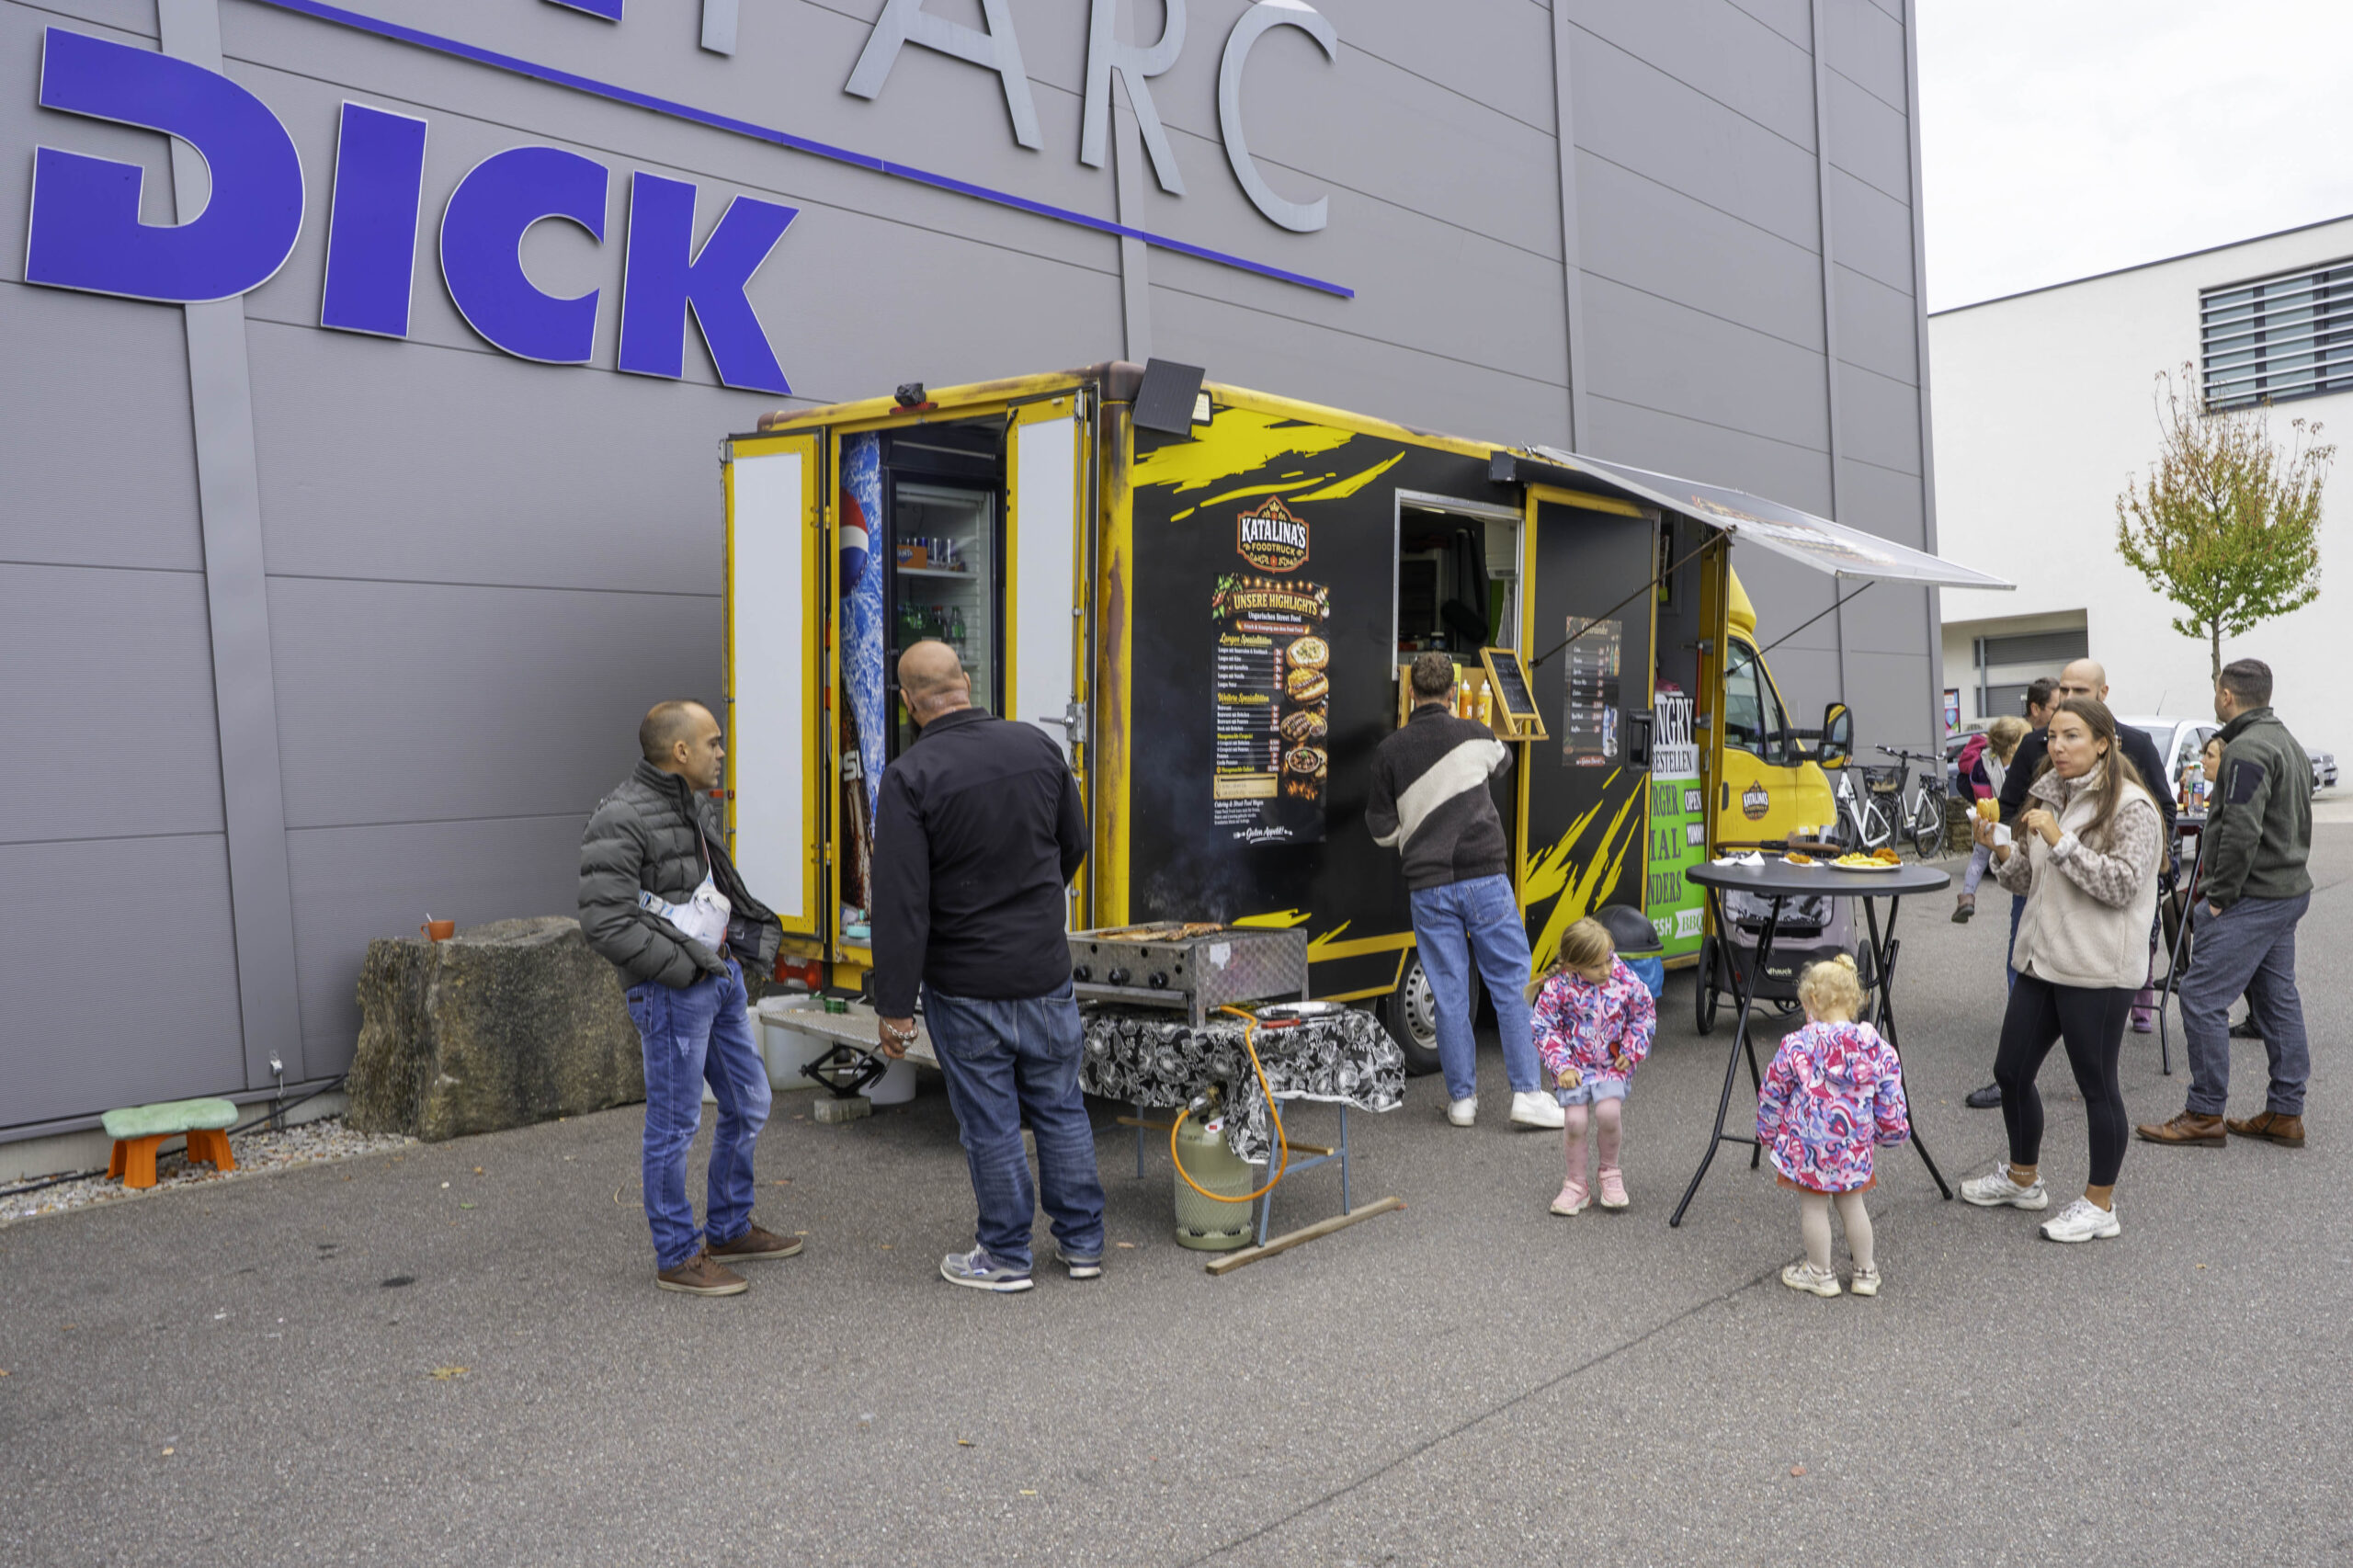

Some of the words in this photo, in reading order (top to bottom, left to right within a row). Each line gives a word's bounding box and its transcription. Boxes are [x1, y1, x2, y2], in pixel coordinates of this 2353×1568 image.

[701, 0, 1337, 233] ARC
[24, 25, 801, 394] DICK
[1241, 517, 1306, 549] KATALINA'S
[1252, 542, 1296, 556] FOODTRUCK
[1233, 593, 1268, 610] UNSERE
[1269, 593, 1317, 616] HIGHLIGHTS
[1276, 613, 1290, 622] Street
[1290, 614, 1302, 623] Food
[1654, 697, 1693, 744] NGRY
[839, 750, 861, 781] SI
[1652, 784, 1679, 816] RGER
[1685, 790, 1701, 811] OPEN
[1650, 827, 1681, 860] IAL
[1647, 870, 1682, 905] NDERS
[1654, 916, 1672, 937] ESH
